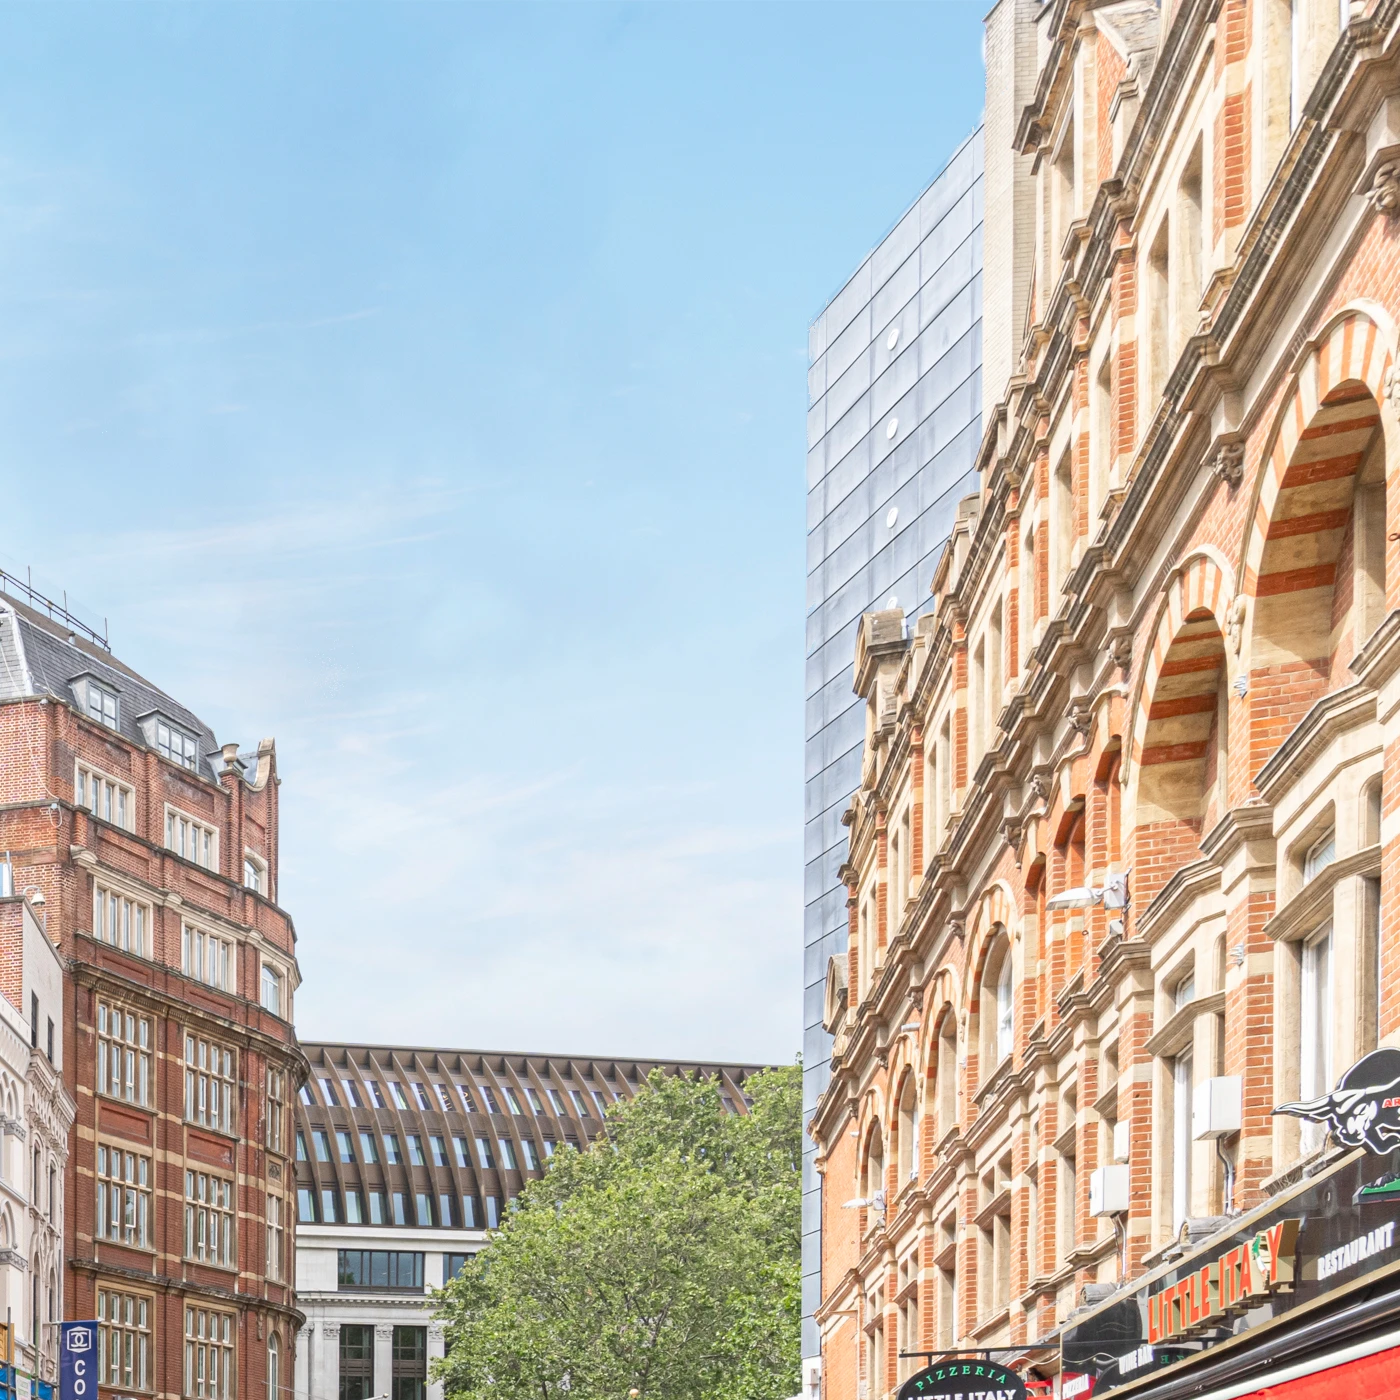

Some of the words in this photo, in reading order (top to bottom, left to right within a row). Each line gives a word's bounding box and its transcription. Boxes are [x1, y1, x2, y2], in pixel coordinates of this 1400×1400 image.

[1317, 1221, 1395, 1281] RESTAURANT
[1147, 1266, 1211, 1344] LITTLE
[915, 1365, 1007, 1391] PIZZERIA
